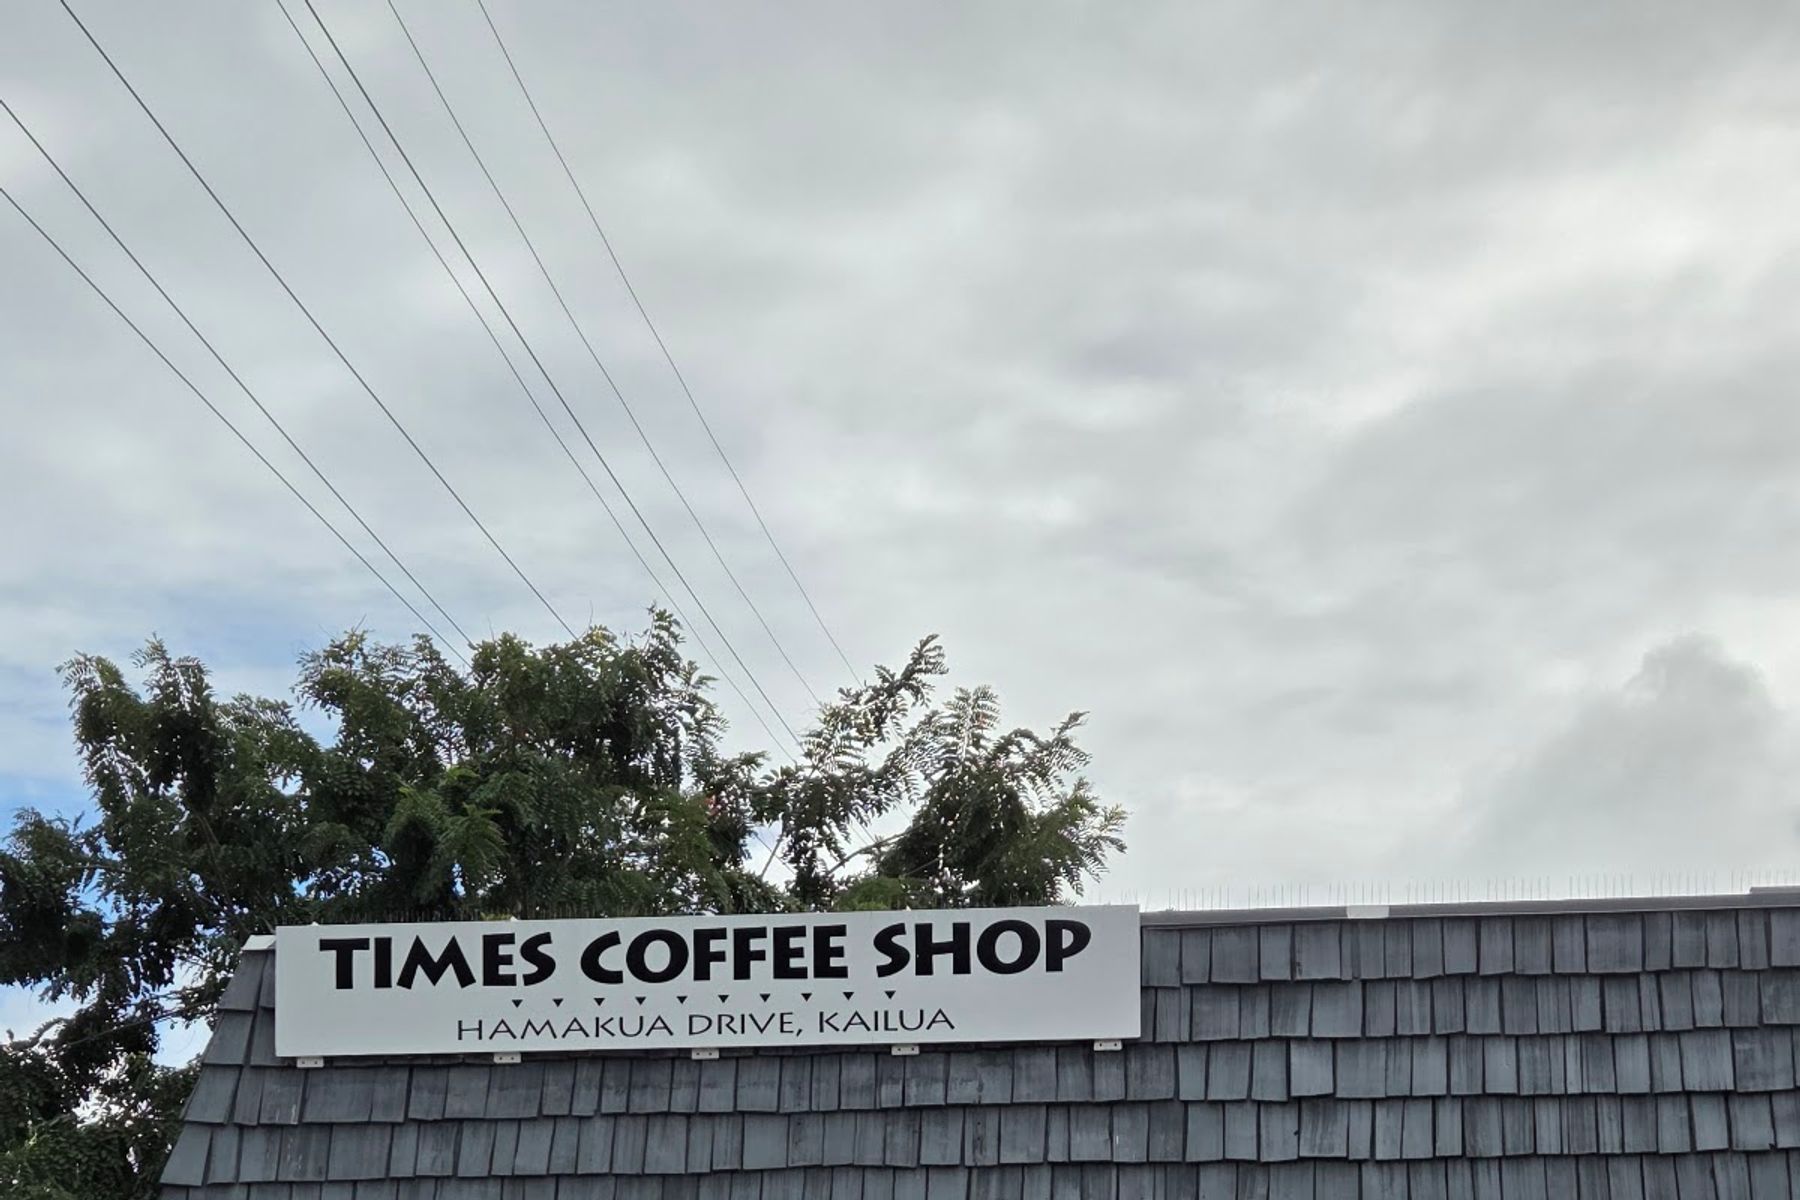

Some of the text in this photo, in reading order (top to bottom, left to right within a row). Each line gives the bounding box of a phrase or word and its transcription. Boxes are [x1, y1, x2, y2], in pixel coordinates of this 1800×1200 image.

[319, 919, 1092, 990] TIMES COFFEE SHOP
[457, 1008, 955, 1041] HAMAKUA DRIVE, KAILUA
